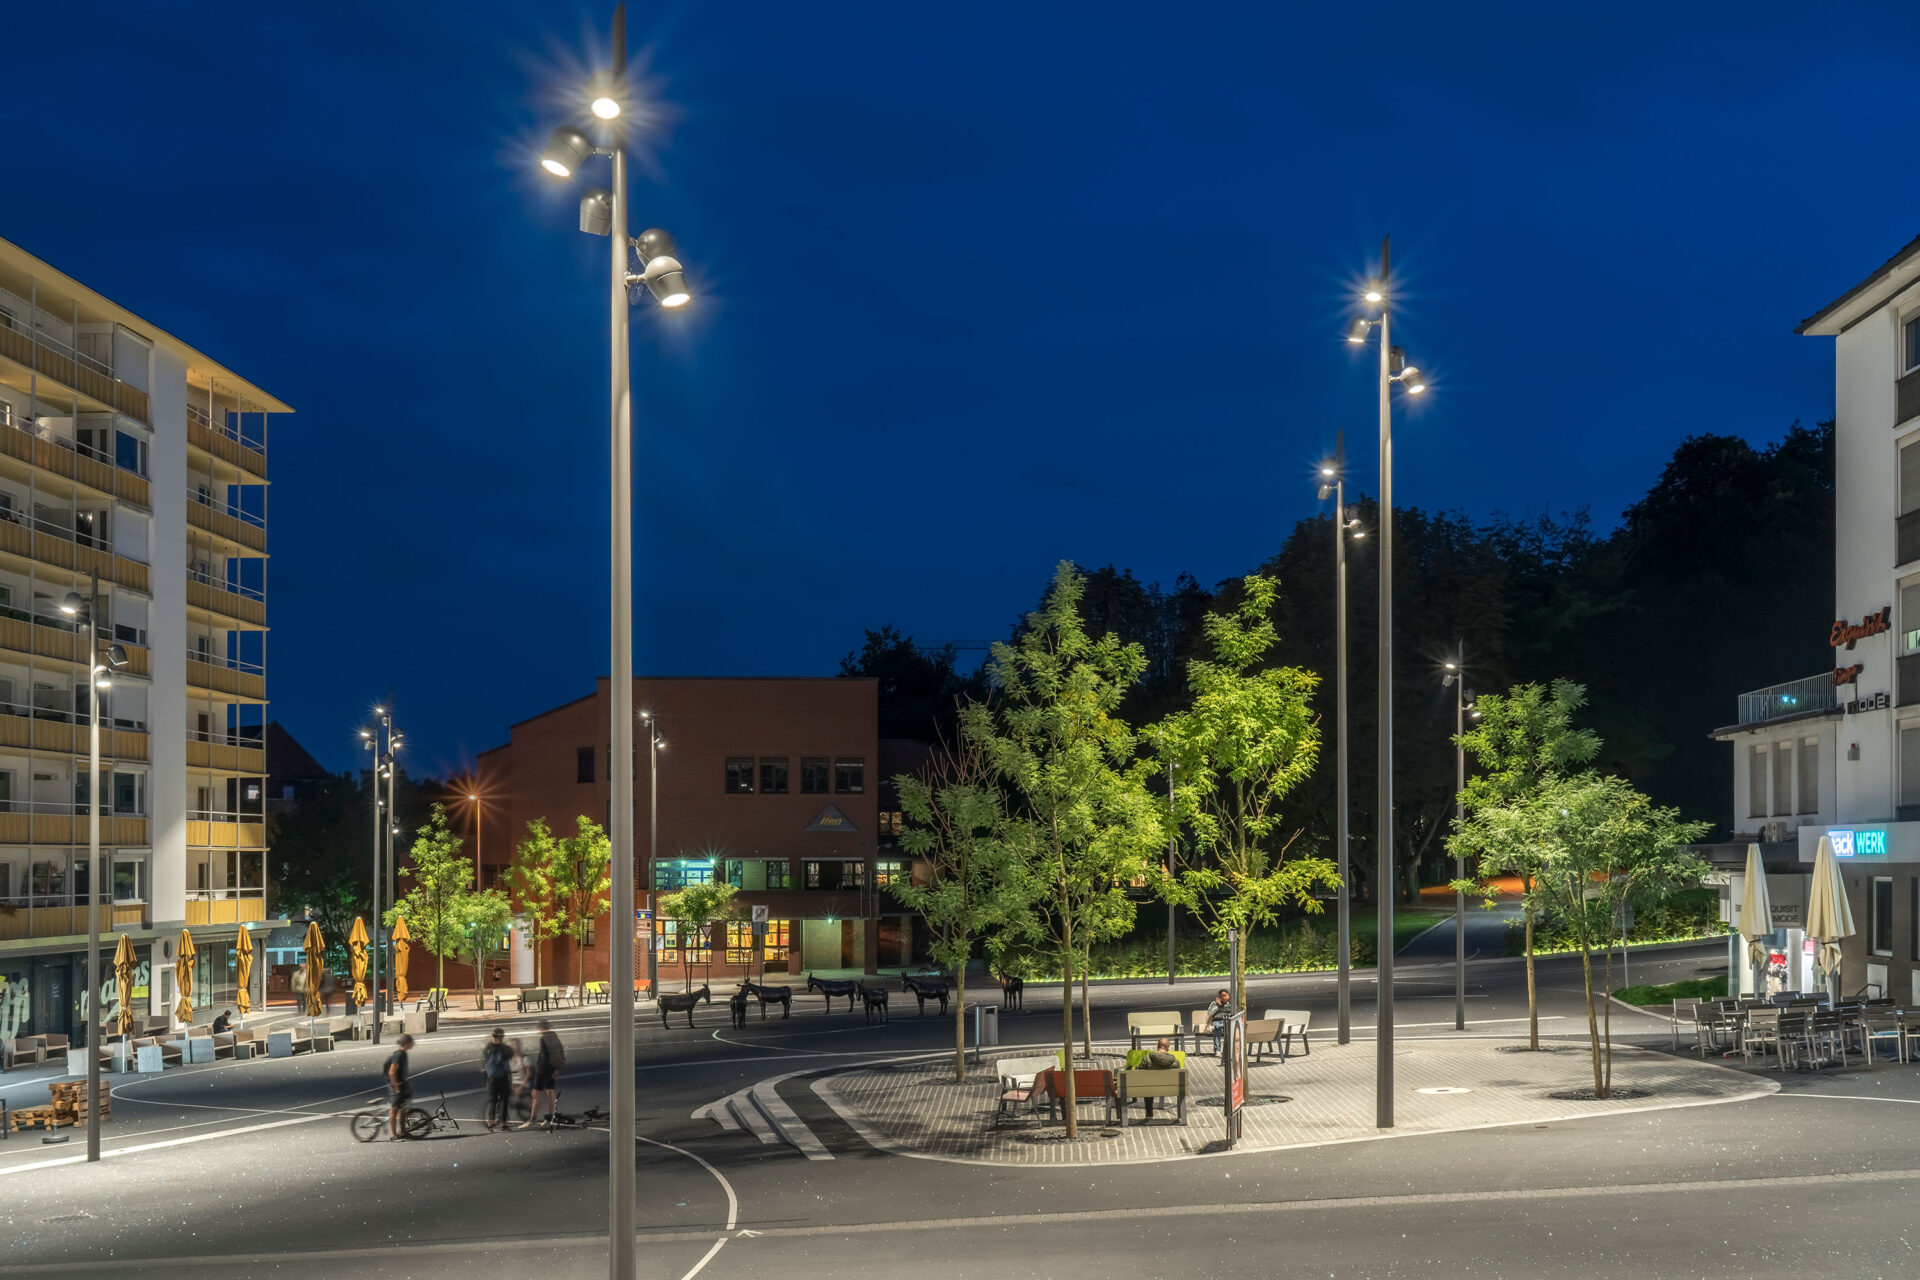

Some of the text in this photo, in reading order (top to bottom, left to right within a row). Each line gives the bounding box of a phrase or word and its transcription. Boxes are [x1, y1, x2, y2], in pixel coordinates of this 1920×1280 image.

[1855, 830, 1886, 854] WERK
[1770, 904, 1800, 914] QUISIT
[1772, 914, 1800, 923] MODE
